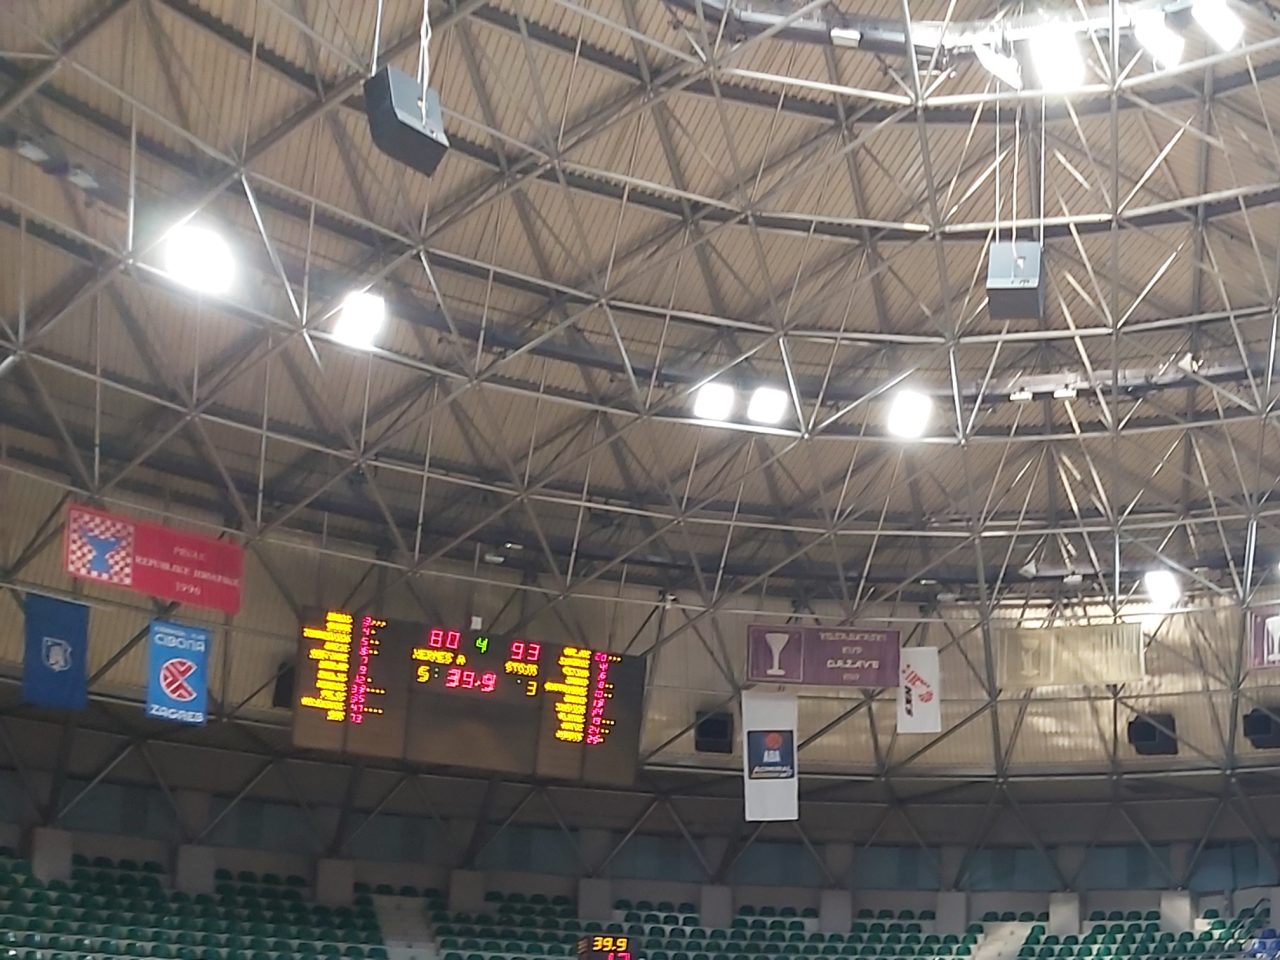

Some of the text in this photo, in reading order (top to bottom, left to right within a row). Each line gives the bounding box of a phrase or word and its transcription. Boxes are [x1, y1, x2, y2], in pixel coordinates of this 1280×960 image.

[429, 630, 460, 649] 80
[476, 638, 488, 653] 4
[511, 643, 540, 660] 93
[445, 669, 496, 692] 39.9
[526, 681, 538, 696] 3
[592, 937, 628, 951] 39.9
